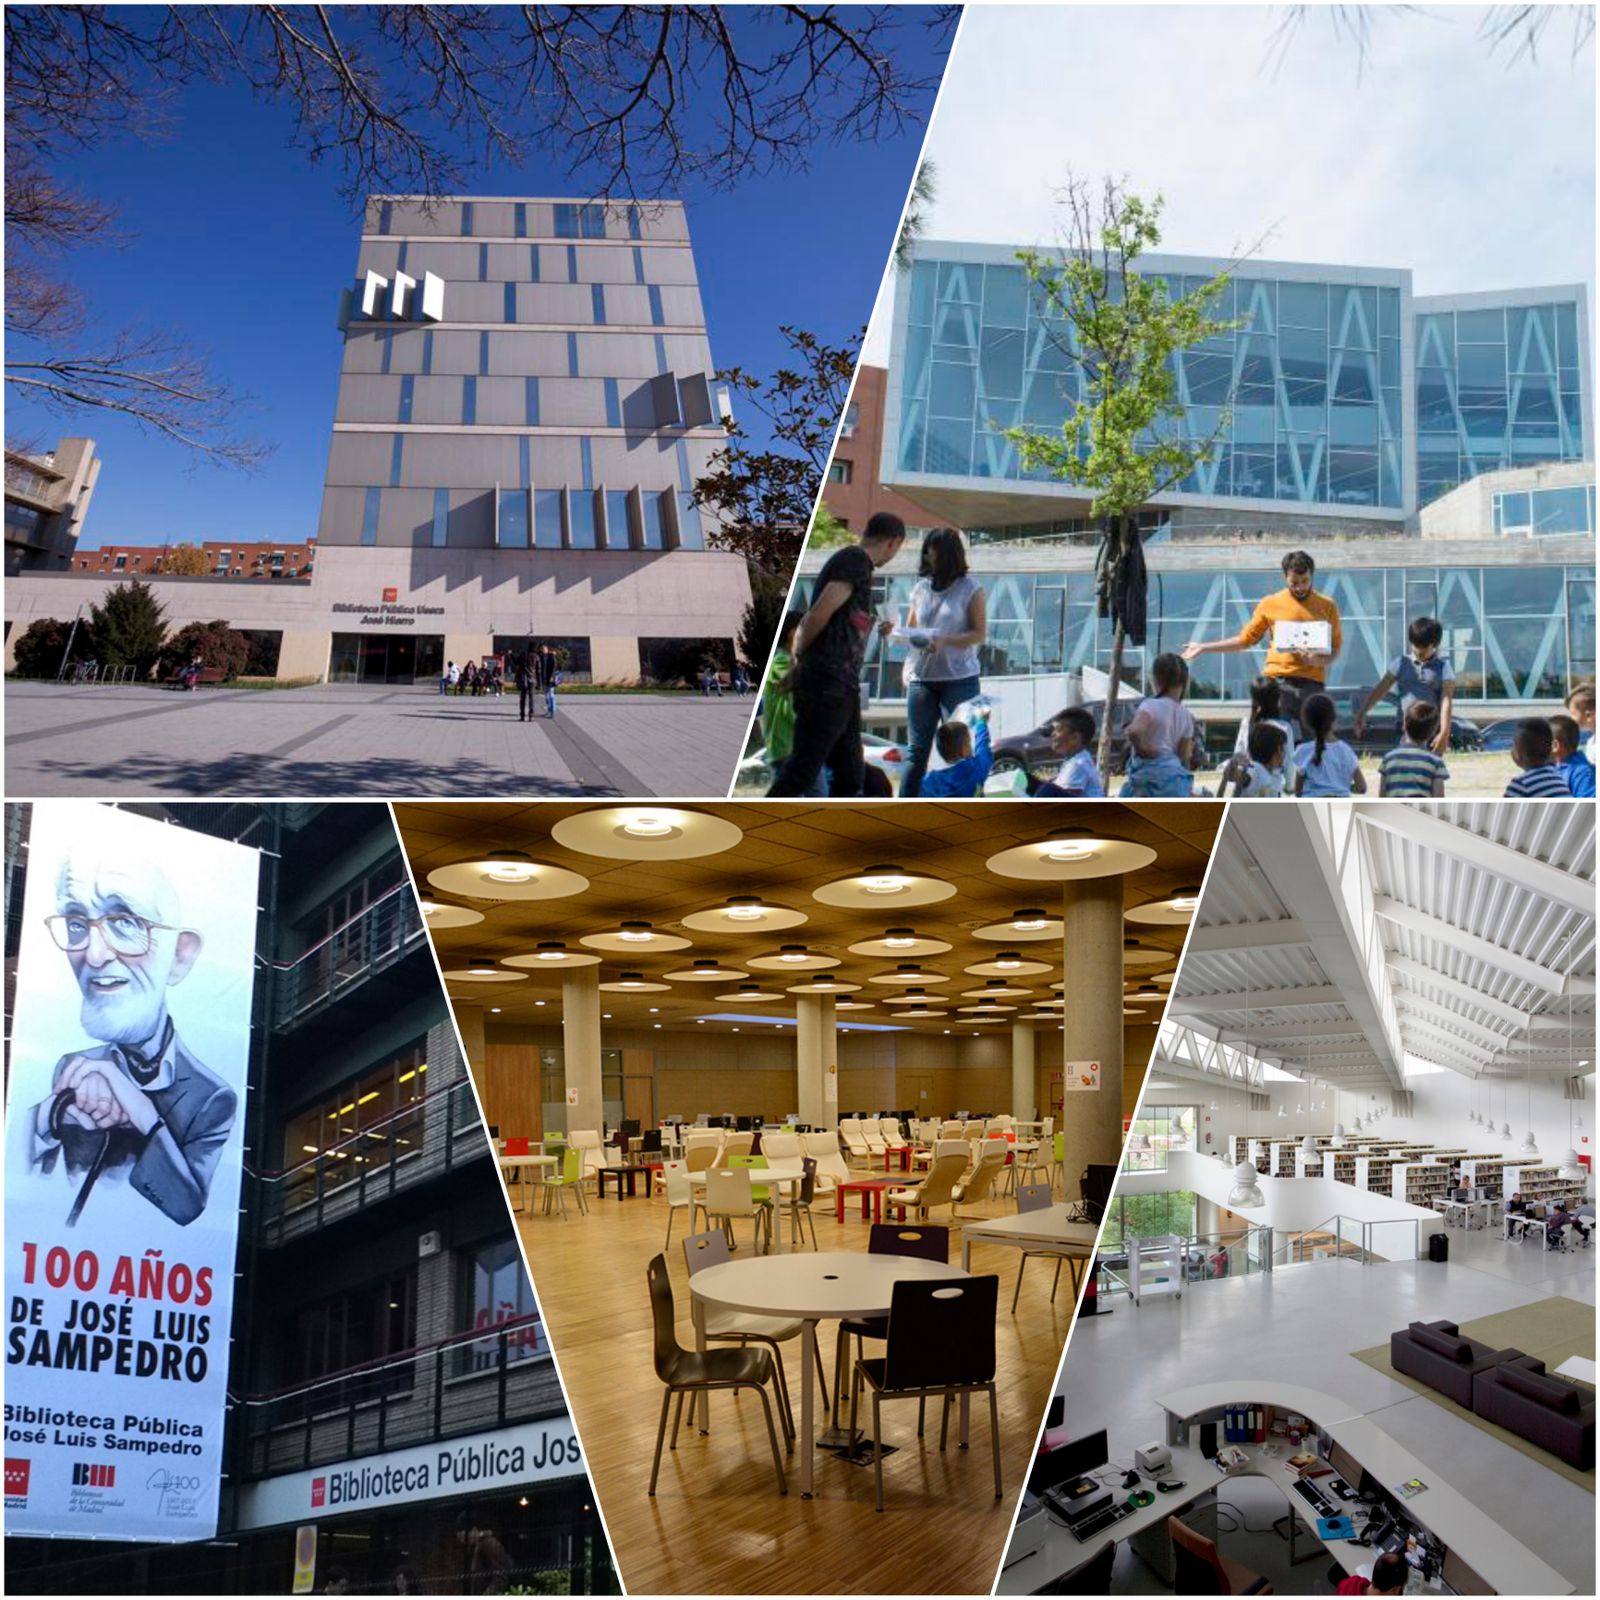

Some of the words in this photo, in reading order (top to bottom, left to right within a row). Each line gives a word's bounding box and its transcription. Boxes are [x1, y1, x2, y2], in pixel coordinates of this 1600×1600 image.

[332, 603, 379, 613] Biblioteca
[22, 1241, 99, 1293] 100
[109, 1248, 214, 1307] AÑOS
[10, 1296, 44, 1325] DE
[65, 1298, 133, 1336] JOSÉ
[153, 1309, 210, 1345] LUIS
[7, 1326, 208, 1383] SAMPEDRO
[4, 1404, 116, 1431] Biblioteca
[123, 1414, 204, 1438] Pública
[4, 1425, 47, 1445] José
[54, 1429, 97, 1448] Luis
[104, 1434, 203, 1457] Sampedro
[329, 1464, 430, 1505] Biblioteca
[437, 1443, 526, 1486] Pública
[533, 1431, 582, 1469] Jos
